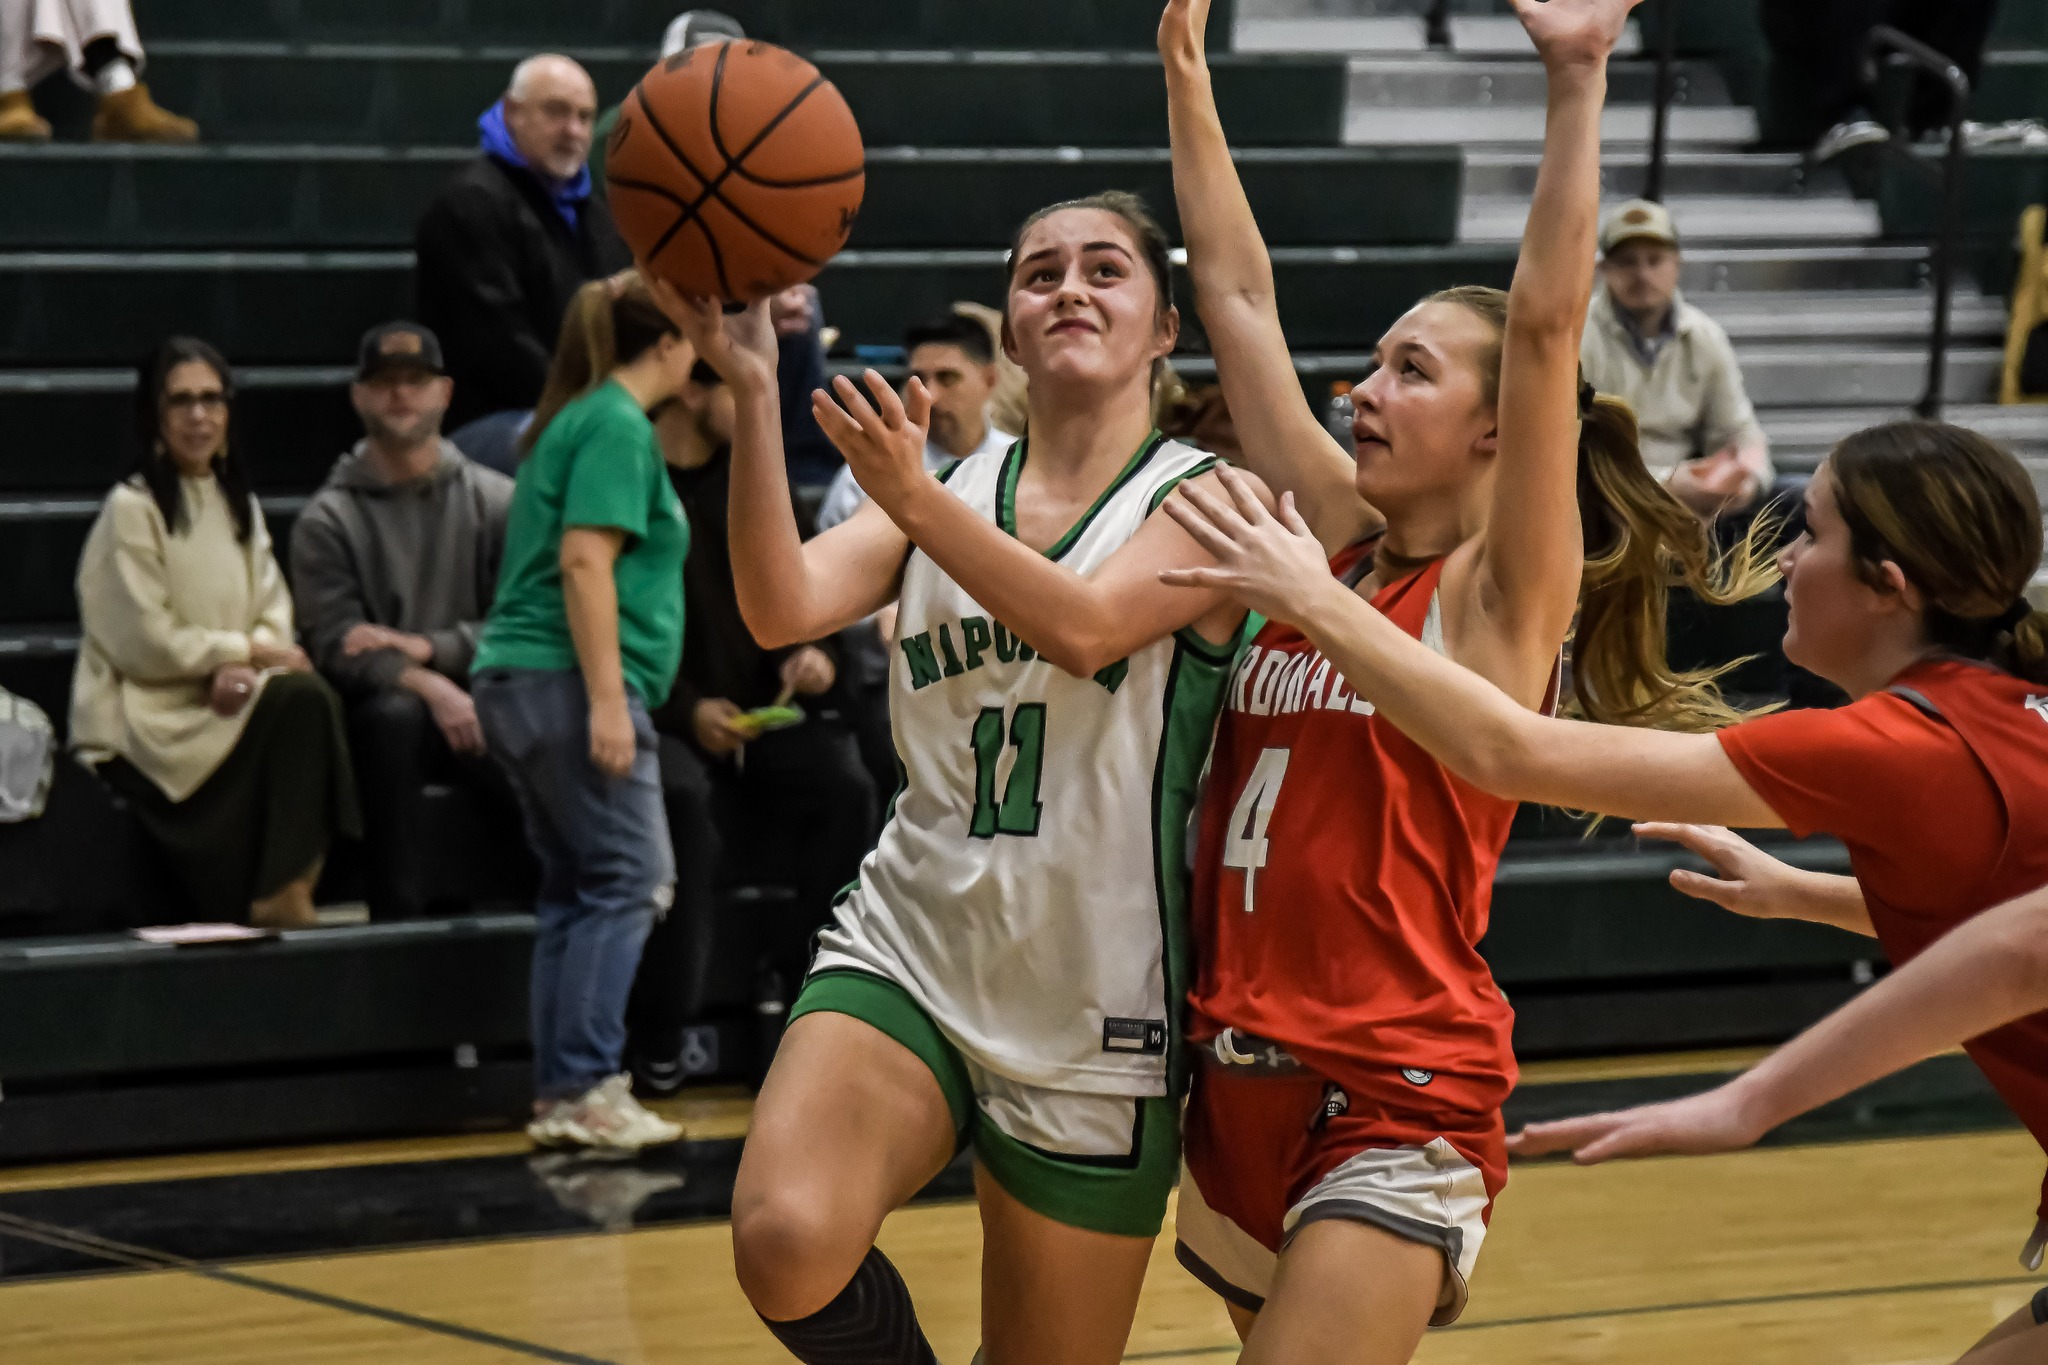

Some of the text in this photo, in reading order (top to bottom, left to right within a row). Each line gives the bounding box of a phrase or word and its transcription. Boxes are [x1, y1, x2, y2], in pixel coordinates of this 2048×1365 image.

[968, 702, 1047, 839] 11
[1224, 748, 1291, 912] 4
[1151, 1030, 1161, 1045] M
